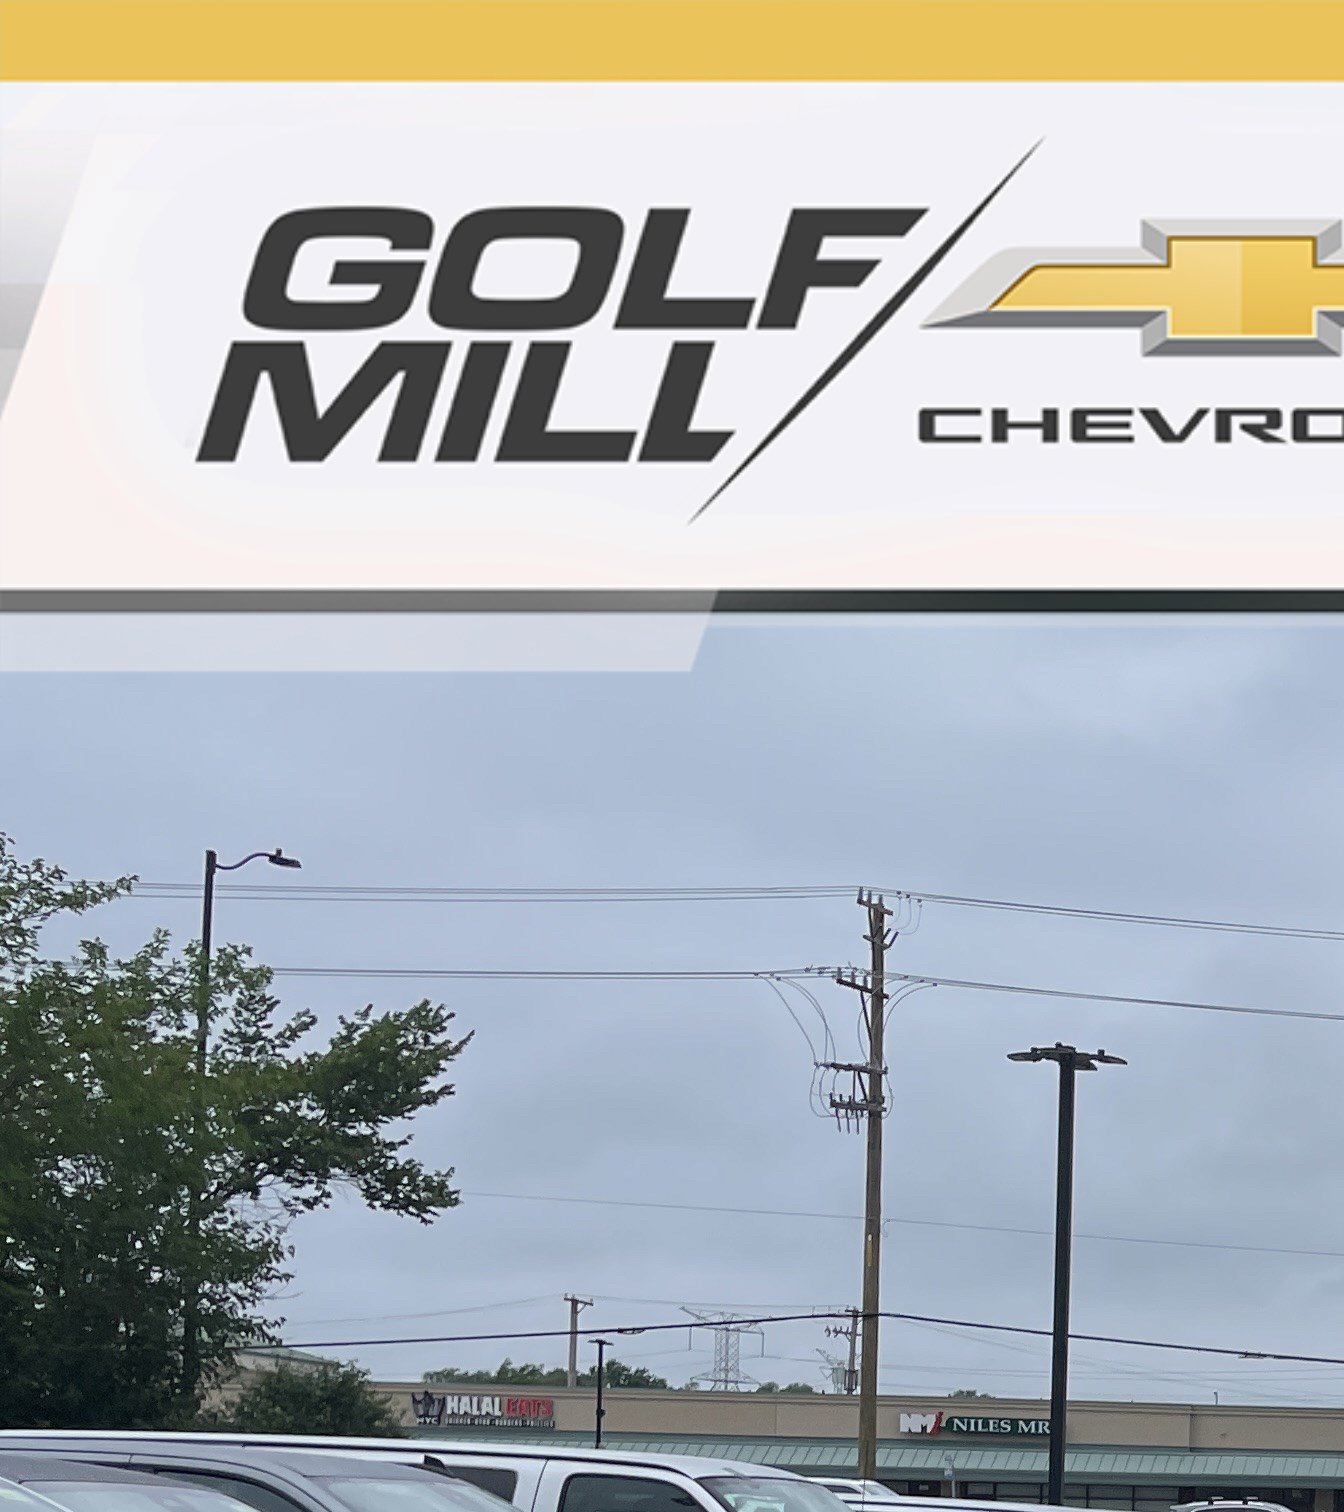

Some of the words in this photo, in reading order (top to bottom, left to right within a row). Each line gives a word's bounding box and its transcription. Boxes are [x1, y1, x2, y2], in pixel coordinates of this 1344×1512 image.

[446, 1395, 503, 1416] HALAL
[506, 1396, 554, 1418] EATS
[952, 1418, 1011, 1433] NILES
